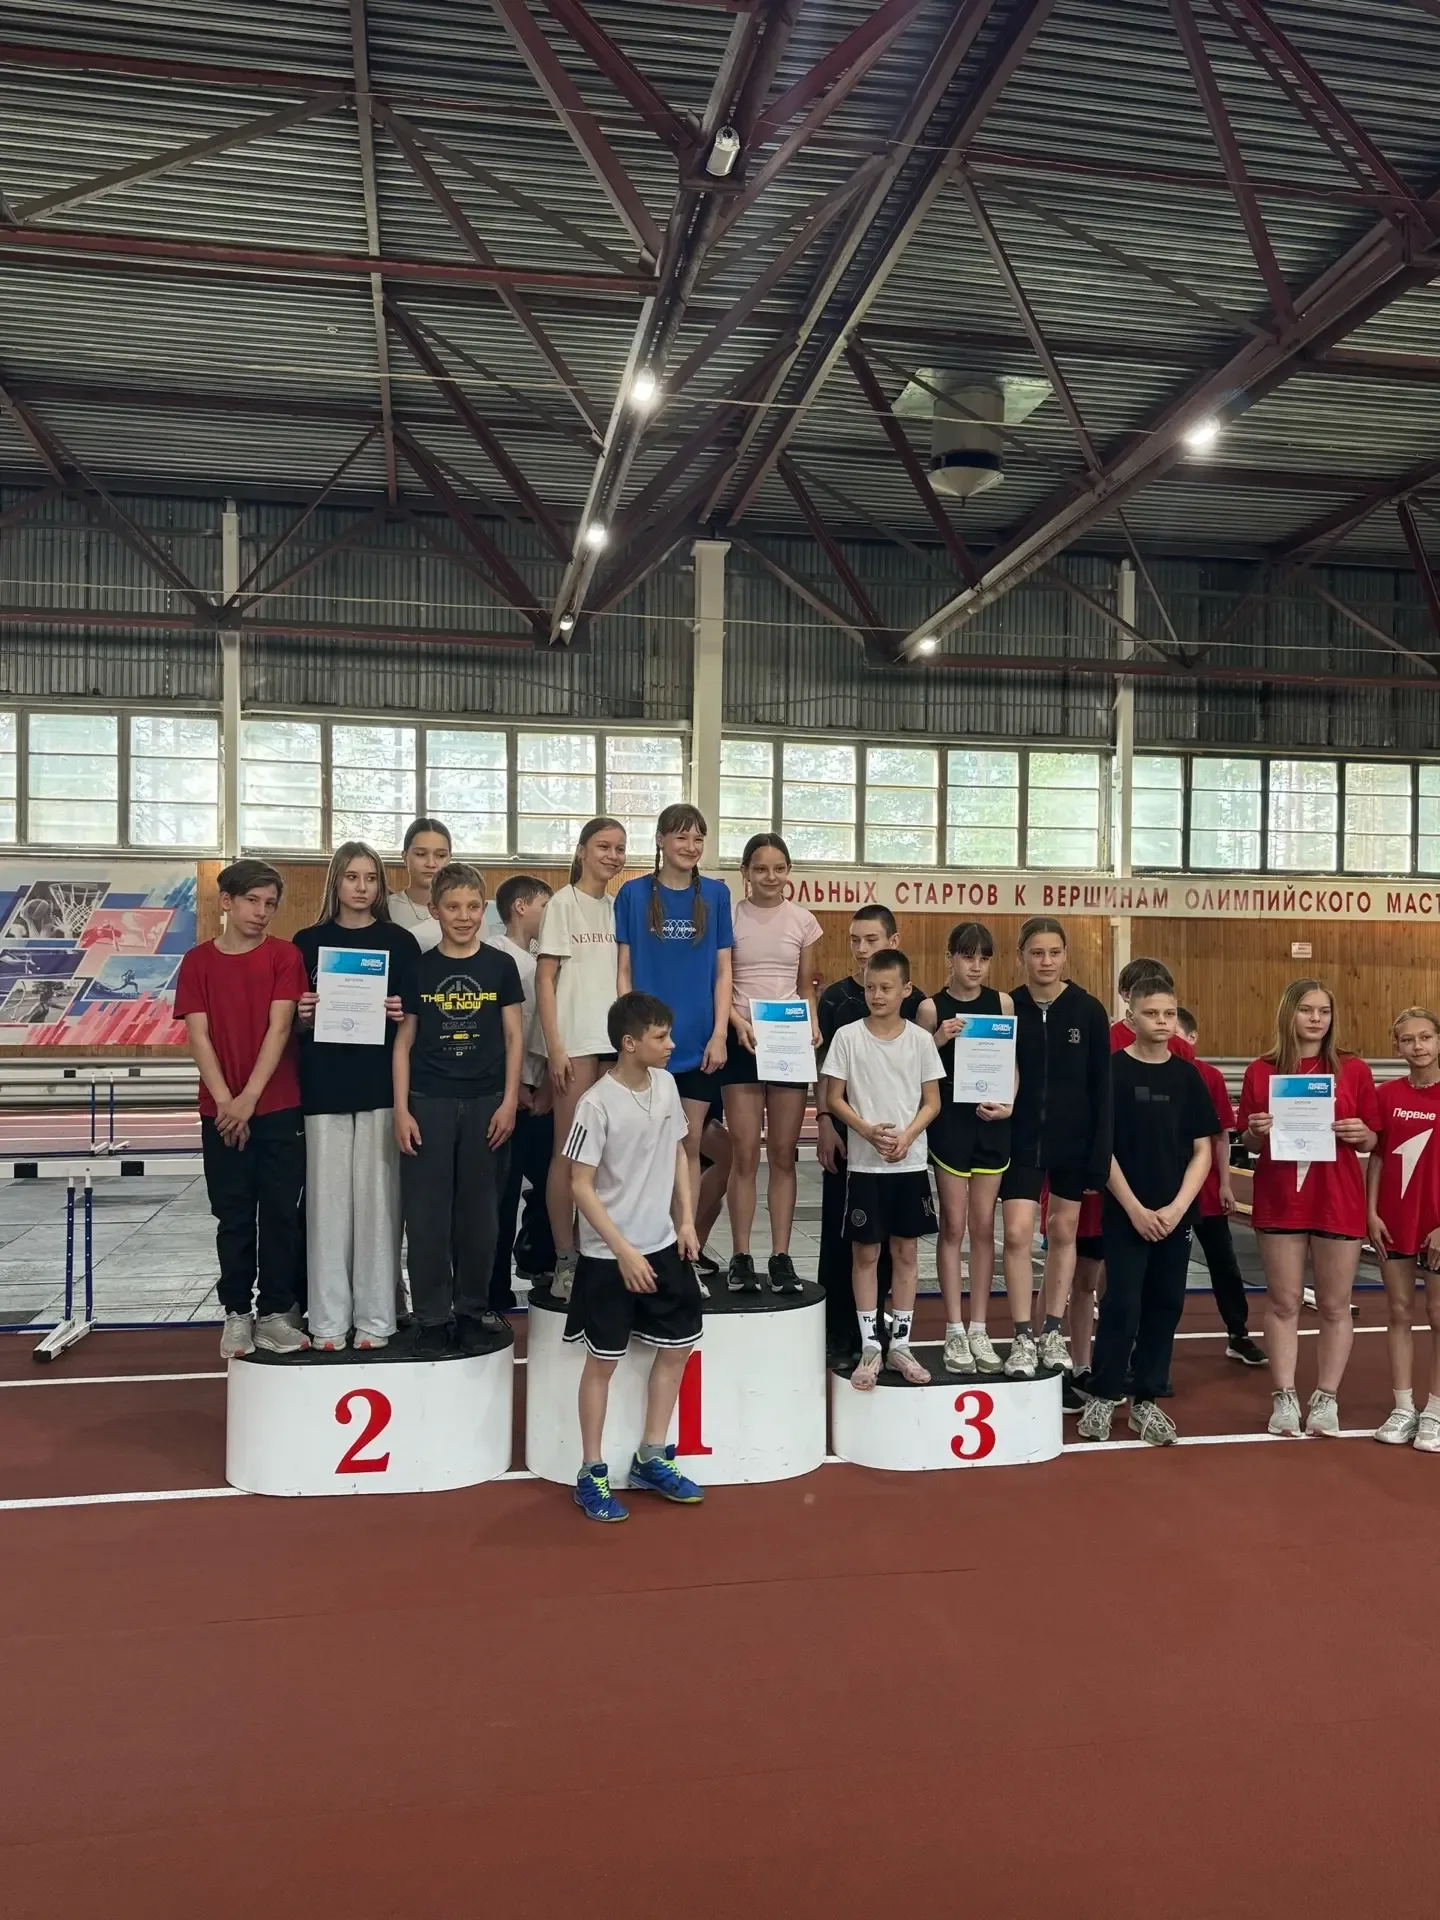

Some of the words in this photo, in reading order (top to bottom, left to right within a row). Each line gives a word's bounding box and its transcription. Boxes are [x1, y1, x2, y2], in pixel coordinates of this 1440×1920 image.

[745, 879, 876, 903] ОЛЬНЫХ
[895, 881, 998, 906] СТАРТОВ
[1014, 884, 1026, 906] К
[1043, 885, 1168, 909] ВЕРШИНАМ
[1185, 884, 1371, 913] ОЛИМПИЙСКОГО
[571, 932, 603, 944] NEVER
[605, 933, 617, 943] GIV
[420, 993, 445, 1003] THE
[448, 992, 497, 1002] FUTURE
[442, 1001, 453, 1010] IS
[456, 1001, 481, 1010] NOW
[1392, 1107, 1437, 1121] Первые
[675, 1350, 713, 1456] 1
[334, 1387, 392, 1474] 2
[950, 1389, 996, 1461] 3
